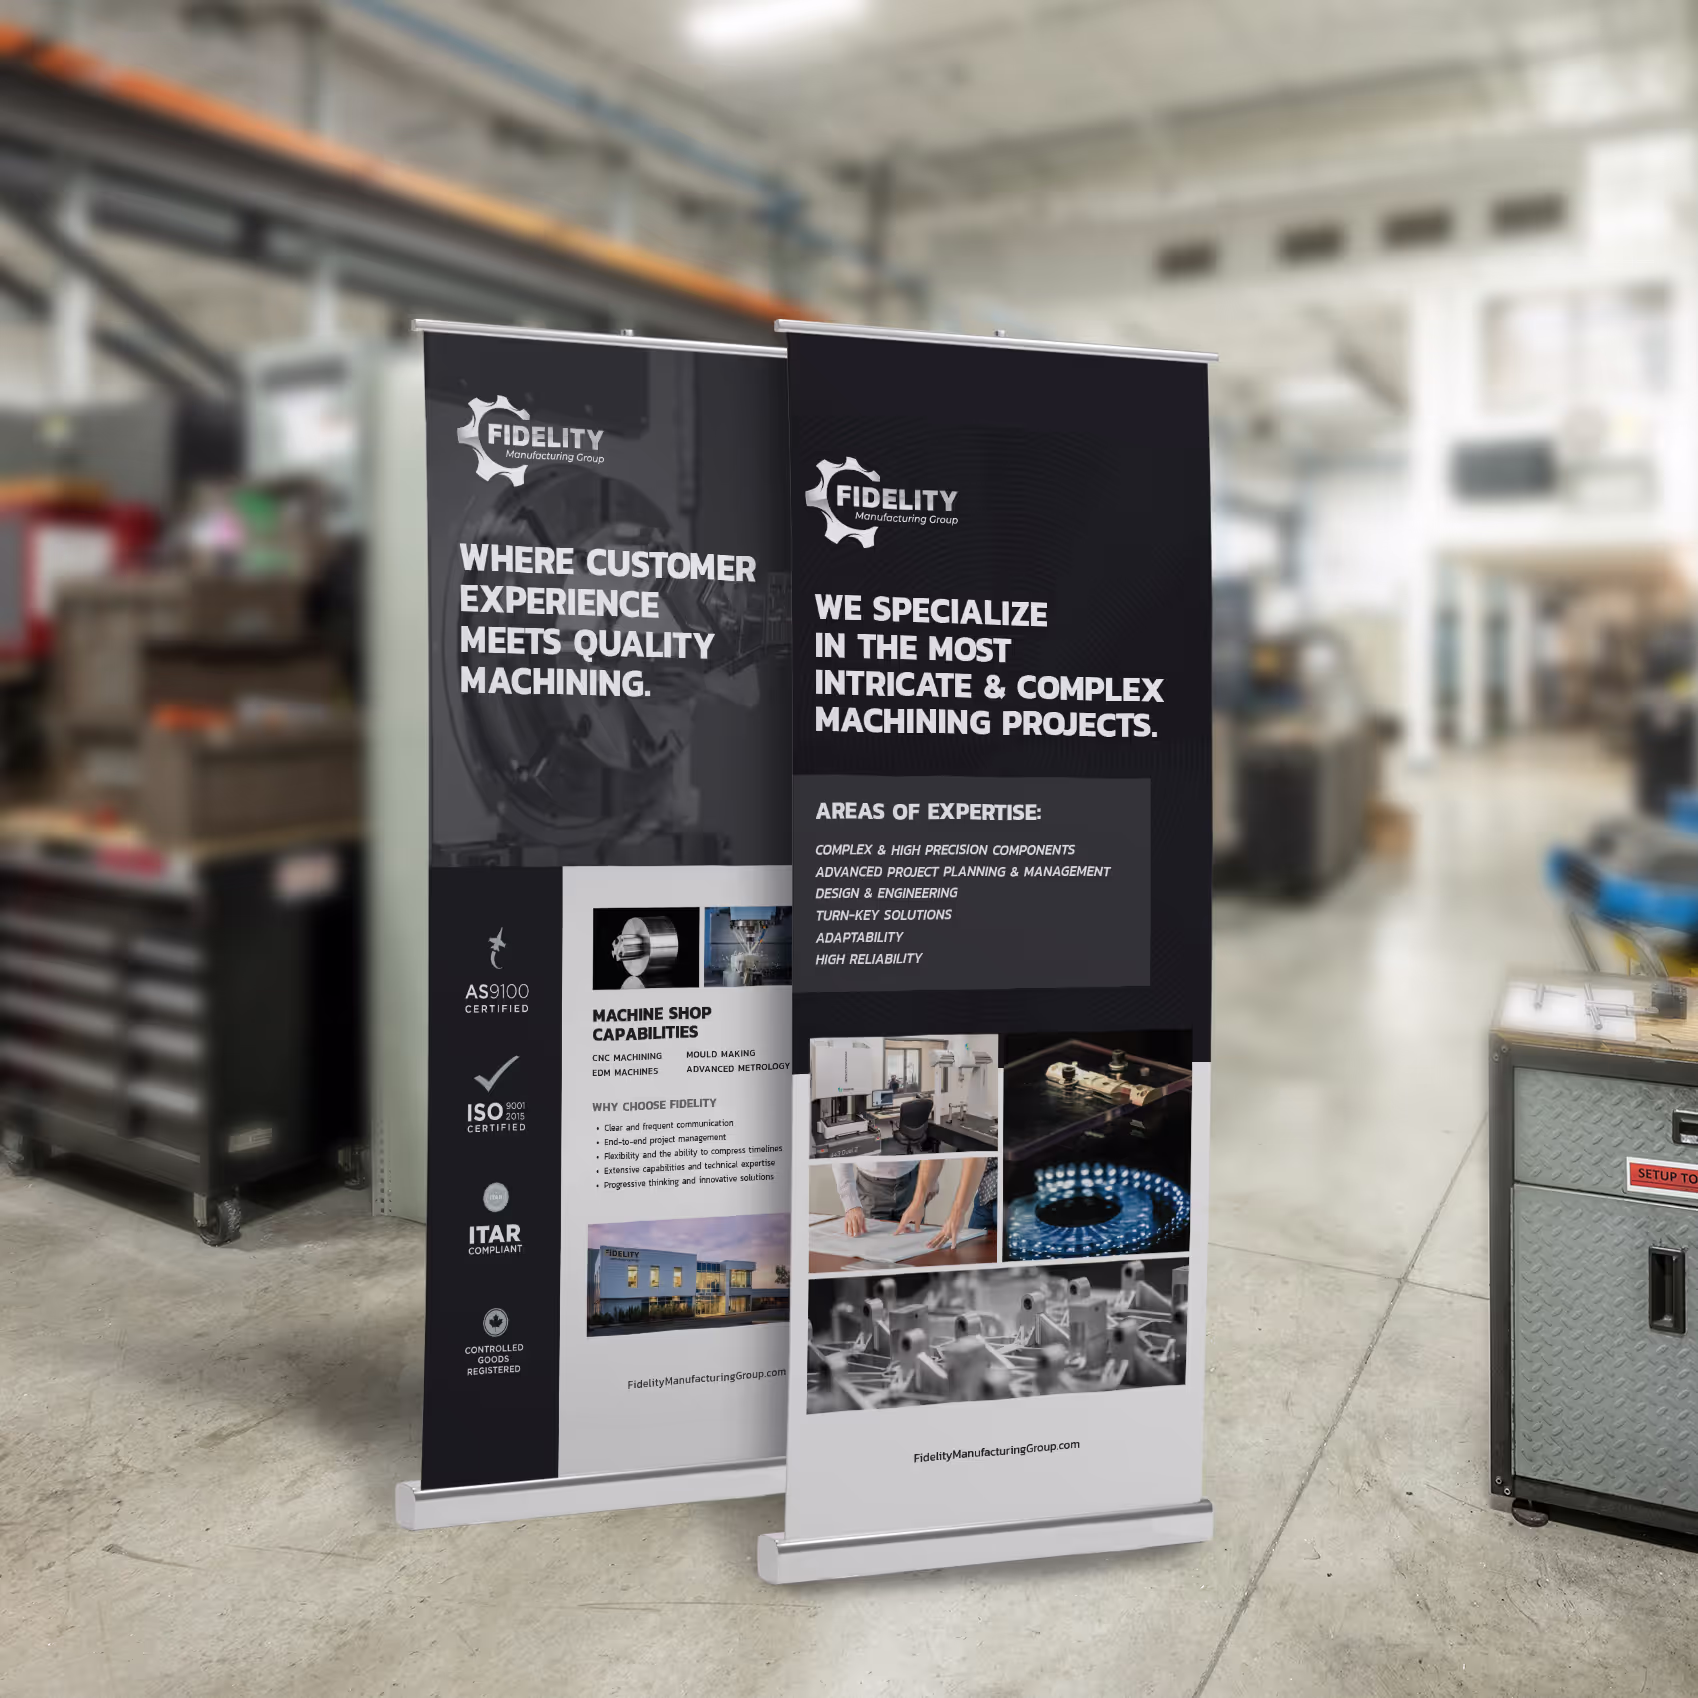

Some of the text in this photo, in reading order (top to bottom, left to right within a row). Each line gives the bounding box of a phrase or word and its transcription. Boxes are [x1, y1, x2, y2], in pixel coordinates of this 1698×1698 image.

[488, 423, 604, 450] FIDELITY
[505, 450, 605, 465] Manufacturing Group
[836, 484, 958, 512] FIDELITY
[855, 511, 959, 526] Manufacturing Group
[459, 543, 757, 582] WHERE CUSTOMER
[460, 584, 659, 618] EXPERIENCE
[814, 593, 1048, 627] WE SPECIALIZE
[460, 625, 715, 663] MEETS QUALITY
[815, 632, 1012, 663] IN THE MOST
[460, 666, 651, 697] MACHINING.
[815, 670, 1164, 703] INTRICATE & COMPLEX
[815, 706, 1158, 738] MACHINING PROJECTS.
[815, 802, 1042, 821] AREAS OF EXPERTISE:
[815, 844, 1076, 856] COMPLEX & HIGH PRECISION COMPONENTS
[815, 866, 1112, 878] ADVANCED PROJECT PLANNING & MANAGEMENT
[815, 887, 959, 899] DESIGN & ENGINEERING
[816, 909, 952, 922] TURN-KEY SOLUTIONS
[815, 932, 904, 944] ADAPTABILITY
[815, 952, 923, 966] HIGH RELIABILITY
[465, 983, 530, 1000] AS9100
[465, 1004, 529, 1014] CERTIFIED
[592, 1006, 712, 1023] MACHINE SHOP
[592, 1025, 699, 1041] CAPABILITIES
[592, 1052, 662, 1062] CNC MACHINING
[686, 1049, 756, 1058] MOULD MAKING
[592, 1067, 659, 1077] EDM MACHINES
[686, 1062, 790, 1073] ADVANCED METROLOGY
[467, 1102, 504, 1122] ISO
[506, 1102, 526, 1110] 9001
[592, 1098, 717, 1112] WHY CHOOSE FIDELITY
[506, 1112, 525, 1121] 2015
[467, 1123, 526, 1133] CERTIFIED
[604, 1119, 734, 1132] Clear and frequent communication
[604, 1133, 727, 1146] End-to-end project management
[604, 1144, 783, 1161] Flexibility and the ability to compress timelines
[604, 1159, 776, 1175] Extensive capabilities and technical expertise
[1638, 1168, 1677, 1181] SETUP
[604, 1173, 774, 1191] Progressive thinking and innovative solutions
[469, 1224, 521, 1244] ITAR
[468, 1244, 523, 1256] COMPLIANT
[605, 1249, 639, 1258] FIDELITY
[465, 1343, 524, 1355] CONTROLLED
[477, 1355, 510, 1364] GOODS
[467, 1365, 521, 1376] REGISTERED
[627, 1368, 786, 1390] FidelityManufacturingGroup.com
[913, 1440, 1080, 1464] FidelityManufacturingGroup.com
